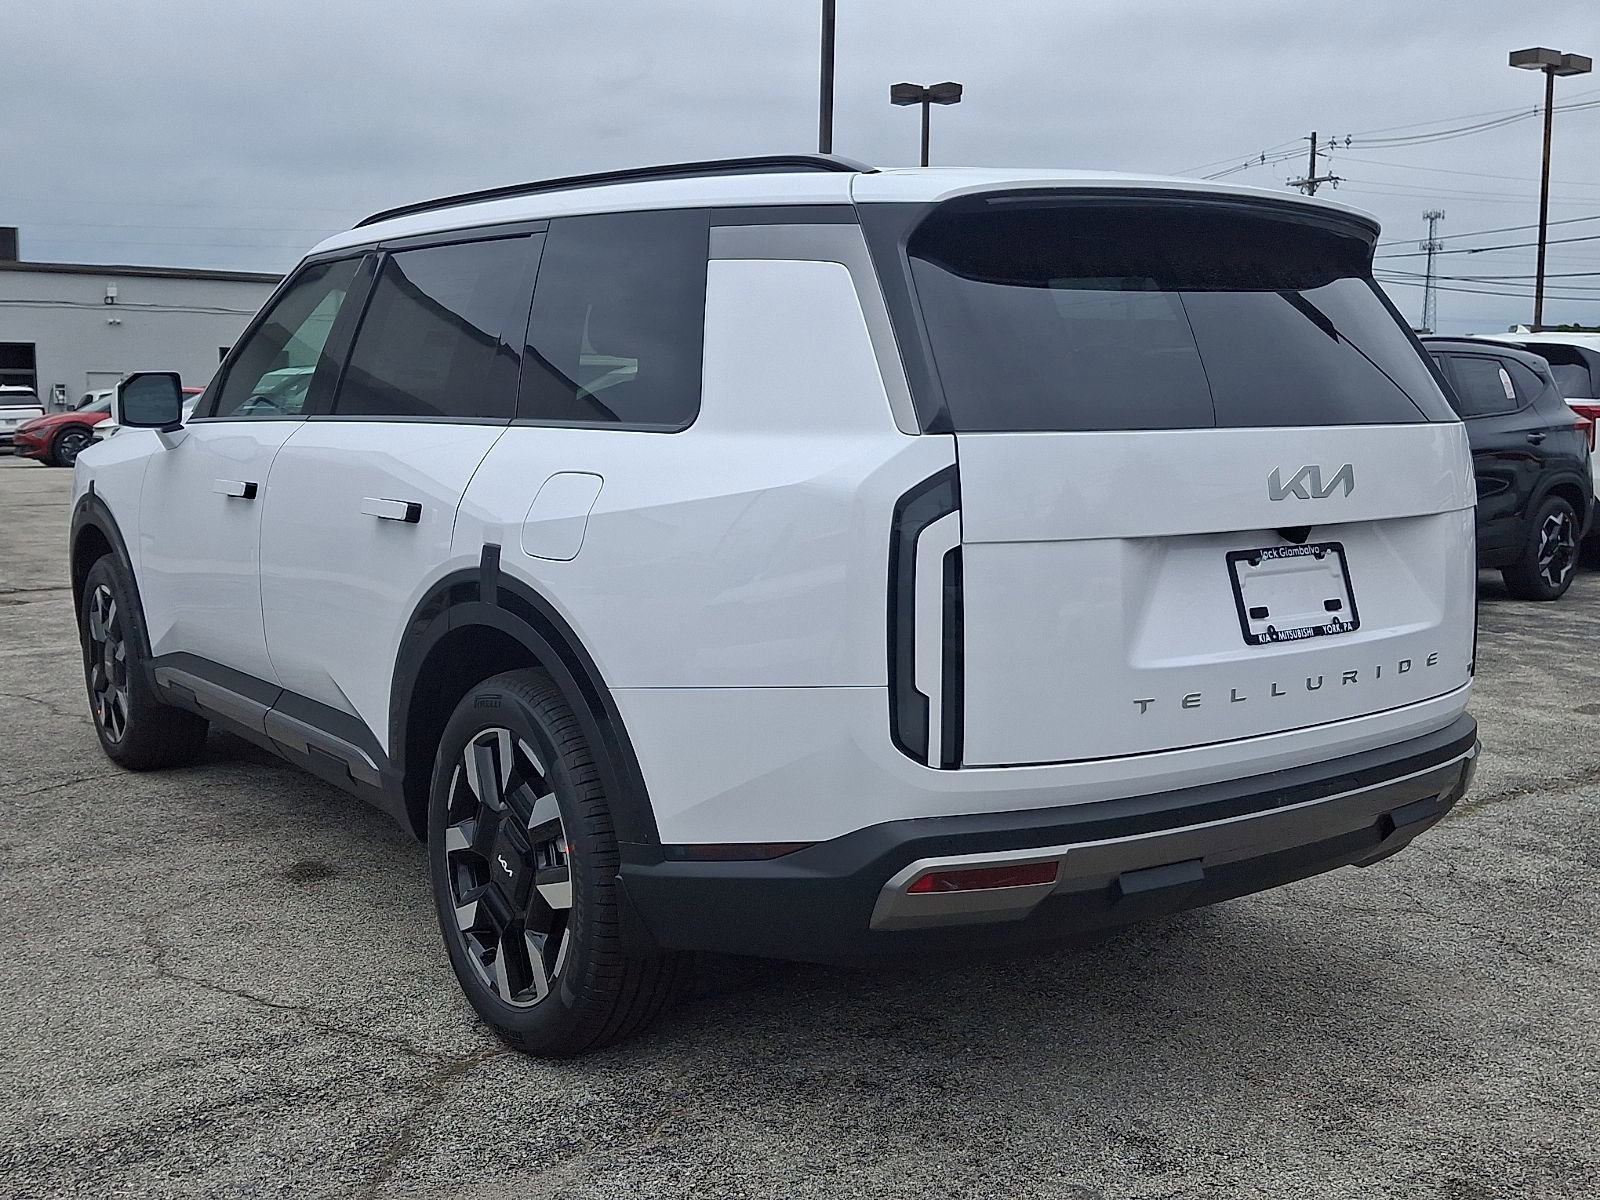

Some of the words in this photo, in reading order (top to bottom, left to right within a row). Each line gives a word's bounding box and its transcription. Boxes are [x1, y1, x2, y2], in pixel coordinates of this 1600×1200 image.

[1267, 463, 1355, 501] KIA
[1258, 632, 1272, 643] KIA
[1278, 627, 1314, 640] MITSUBISHI
[1343, 622, 1353, 631] PA
[1133, 652, 1439, 715] TELLURIDE
